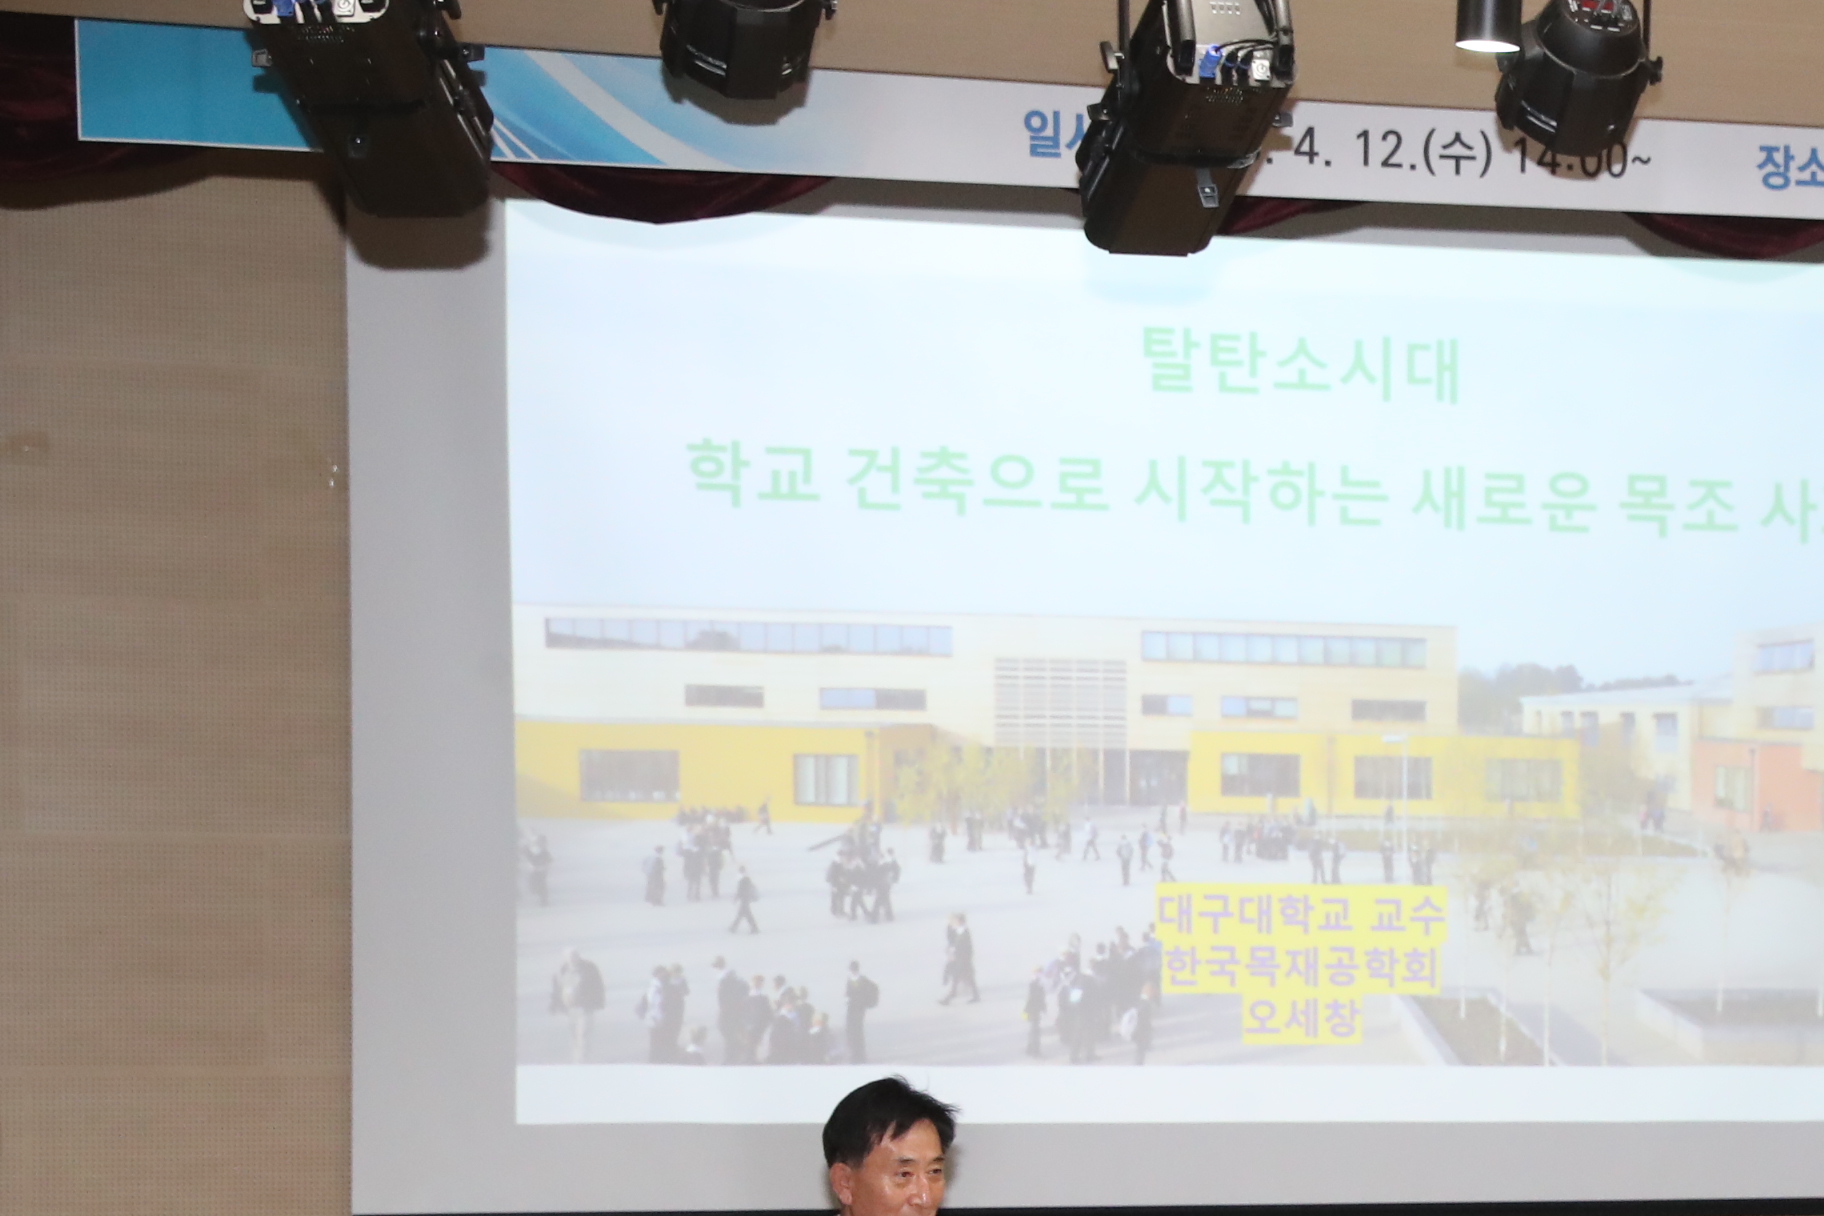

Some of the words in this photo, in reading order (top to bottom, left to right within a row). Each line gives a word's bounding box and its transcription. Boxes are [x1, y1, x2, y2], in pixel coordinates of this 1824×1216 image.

[1141, 325, 1460, 405] 탈탄소시대
[685, 436, 822, 509] 학교
[846, 444, 1111, 517] 건축으로
[1133, 454, 1390, 526] 시작하는
[1411, 464, 1598, 534] 새로운
[1618, 473, 1739, 538] 목조
[1158, 893, 1354, 936] 대구대학교
[1370, 895, 1446, 937] 교수
[1164, 945, 1437, 988] 한국목재공학회
[1244, 997, 1362, 1039] 오세창
